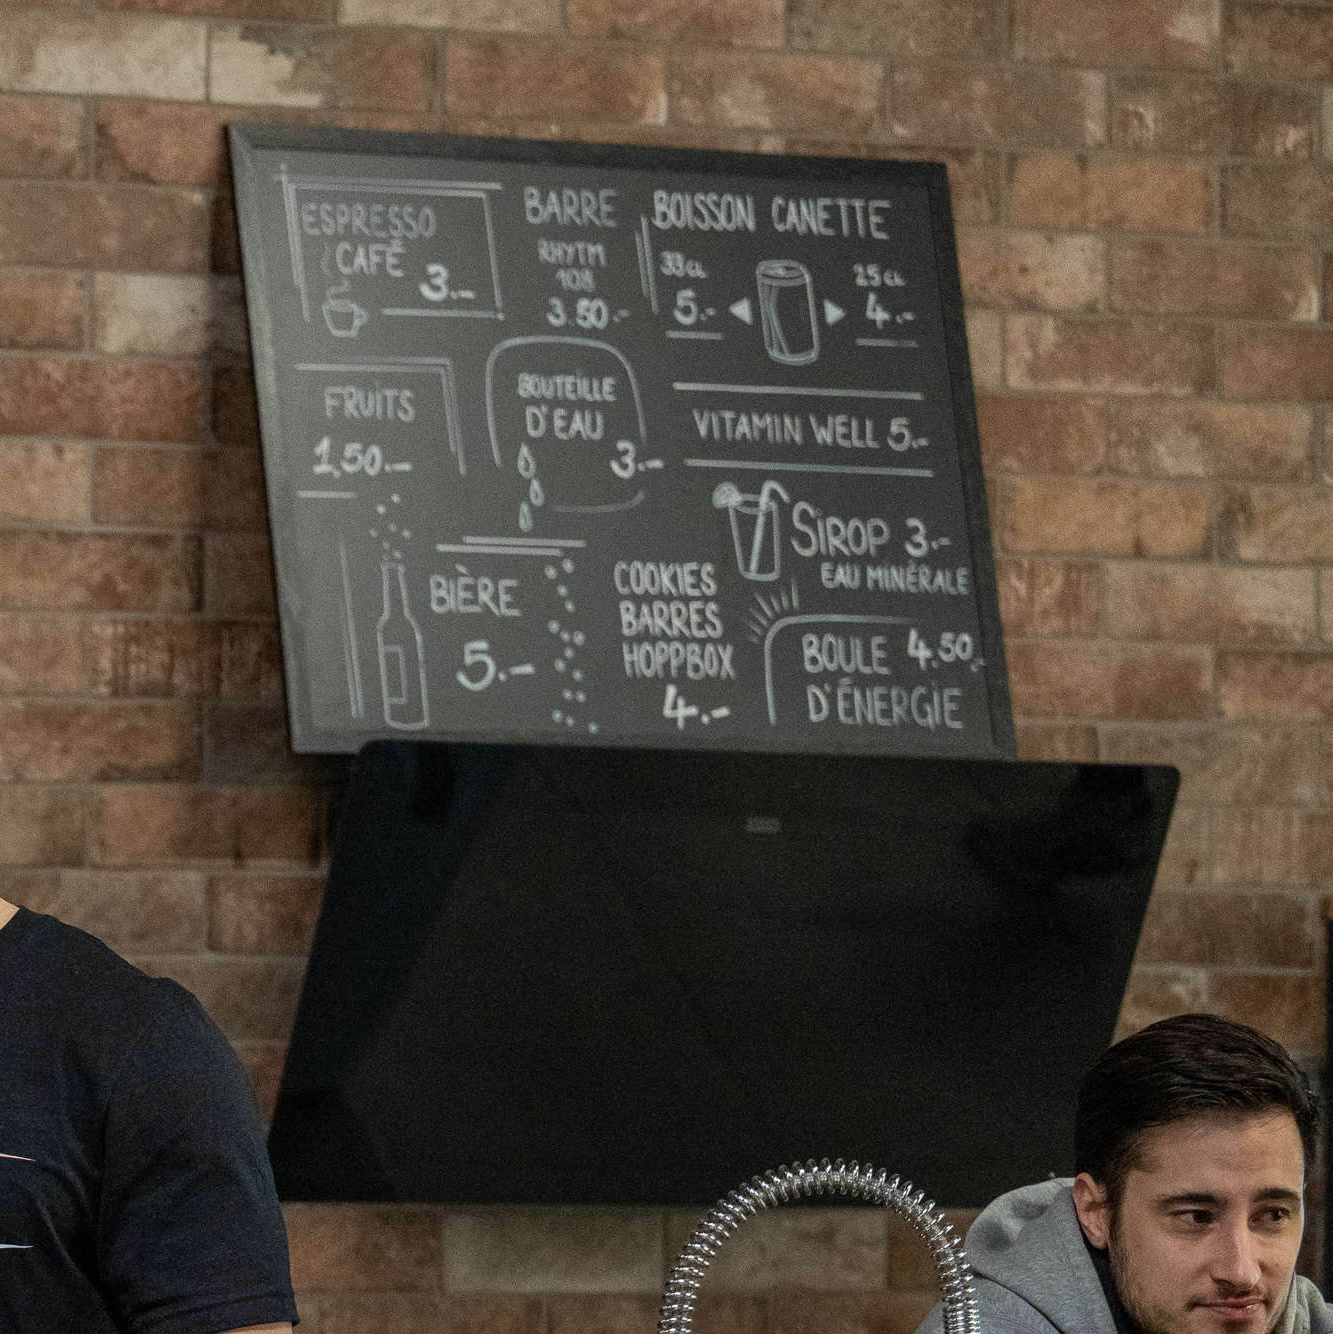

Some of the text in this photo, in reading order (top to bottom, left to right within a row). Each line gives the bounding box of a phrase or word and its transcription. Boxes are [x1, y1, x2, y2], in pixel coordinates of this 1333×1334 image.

[301, 202, 436, 239] ESPRESSO
[523, 186, 617, 227] BARRE
[651, 189, 892, 240] BOISSON CANETTE
[525, 404, 604, 441] D'EAU
[692, 408, 805, 446] VITAMIN
[809, 412, 881, 449] WELL
[429, 563, 522, 617] BIÈRE
[613, 560, 718, 597] COOKIES
[820, 559, 970, 595] EAU MINÉRALE
[619, 600, 724, 639] BARRES
[622, 641, 737, 681] HOPPBOX
[802, 633, 891, 675] BOULE
[806, 677, 964, 729] D'ÉNERGIE
